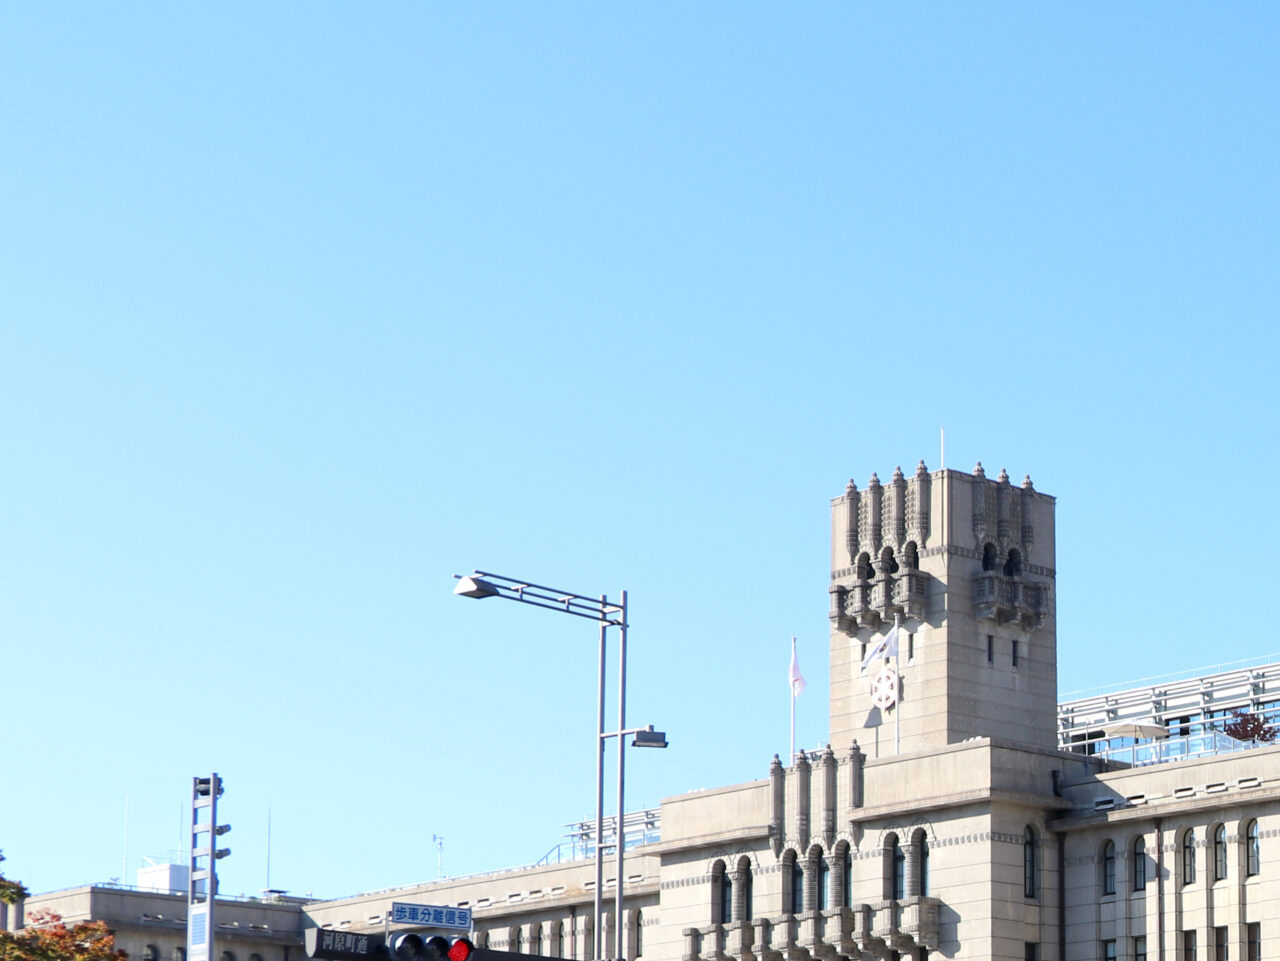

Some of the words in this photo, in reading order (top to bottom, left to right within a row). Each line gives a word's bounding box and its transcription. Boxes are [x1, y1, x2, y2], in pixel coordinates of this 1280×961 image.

[395, 906, 470, 926] 歩車分離信号
[322, 931, 368, 954] 河原町通
